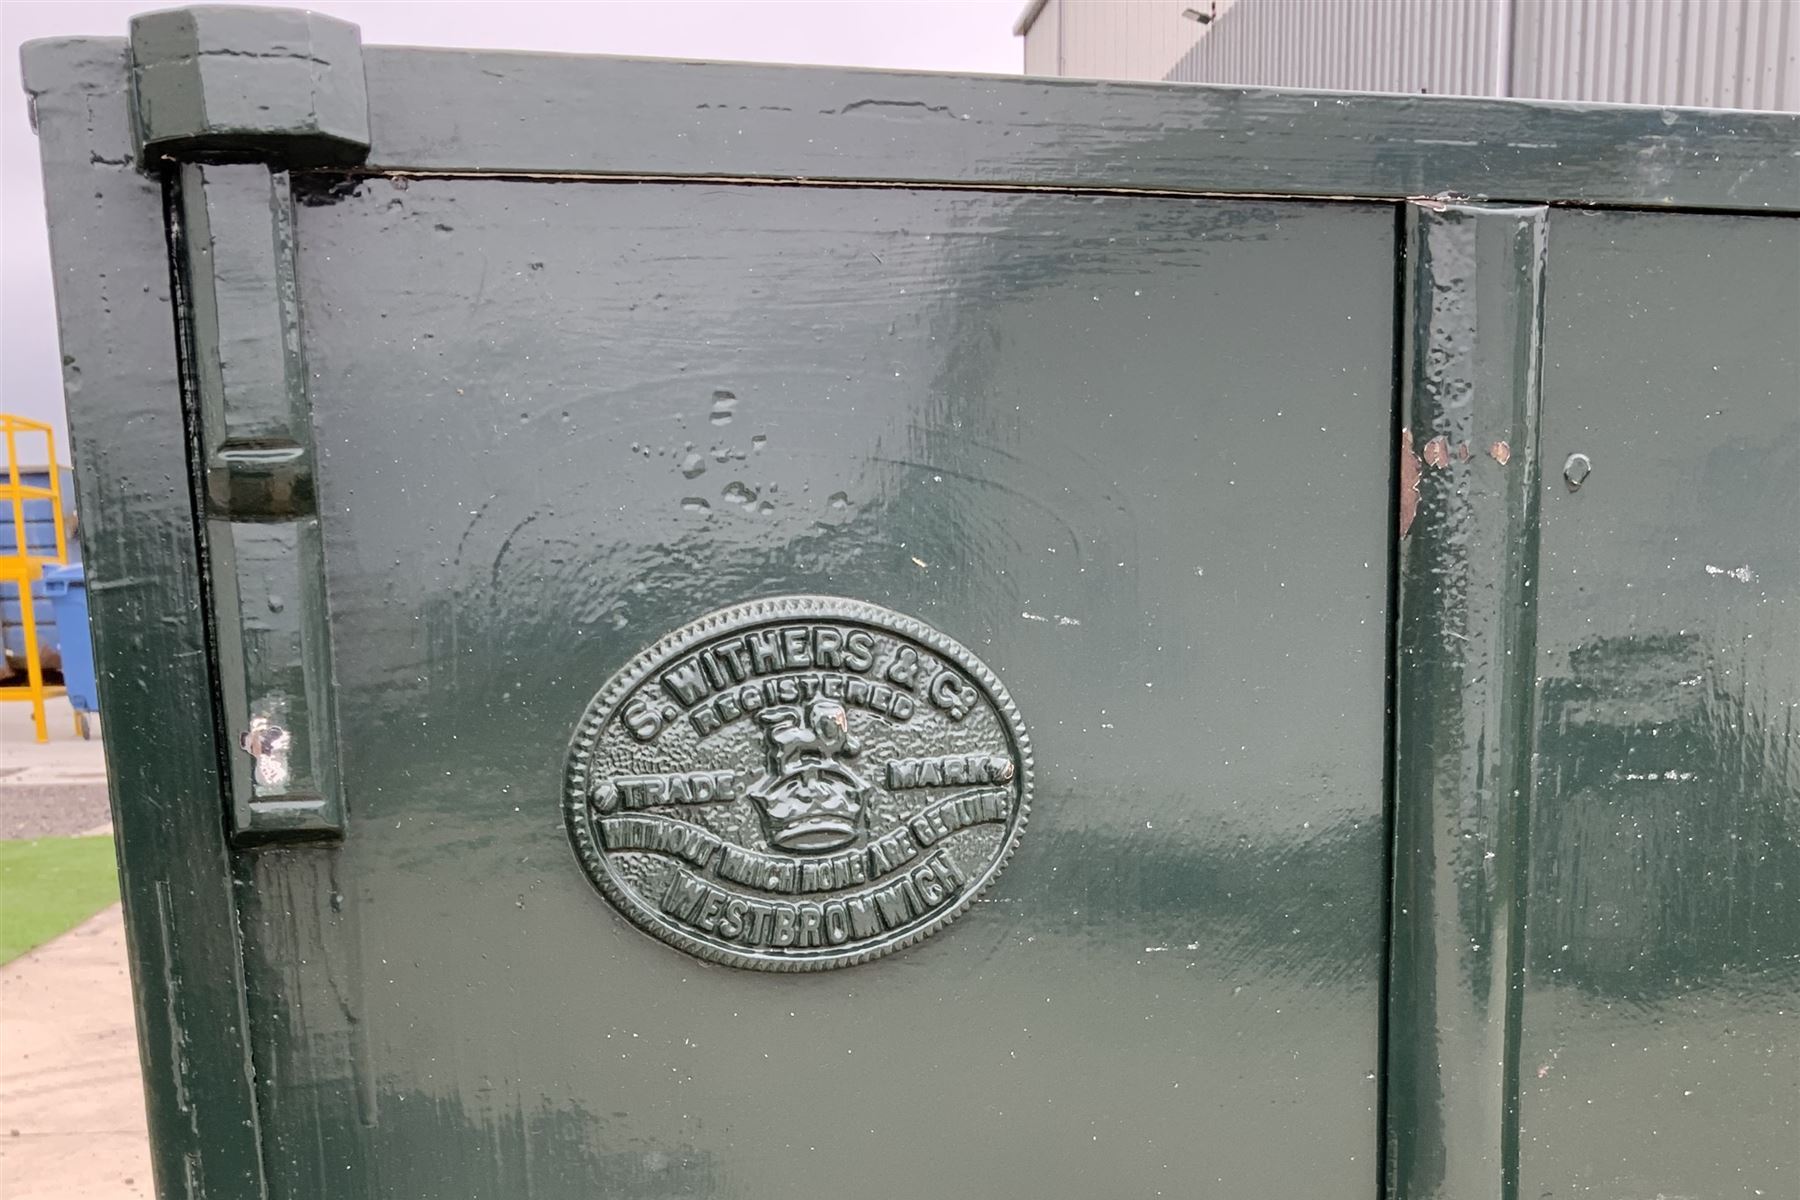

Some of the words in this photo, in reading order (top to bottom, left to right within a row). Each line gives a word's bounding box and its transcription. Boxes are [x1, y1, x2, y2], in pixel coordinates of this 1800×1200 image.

[661, 627, 874, 706] WITHERS
[888, 645, 918, 692] &
[689, 673, 914, 736] REGISTERED
[616, 774, 735, 807] TRADE
[887, 757, 991, 789] MARK
[603, 816, 721, 867] WITHOUT
[718, 846, 797, 893] WHICH
[801, 854, 865, 892] NONE
[866, 828, 918, 880] ARE
[911, 791, 1009, 847] GENUINE
